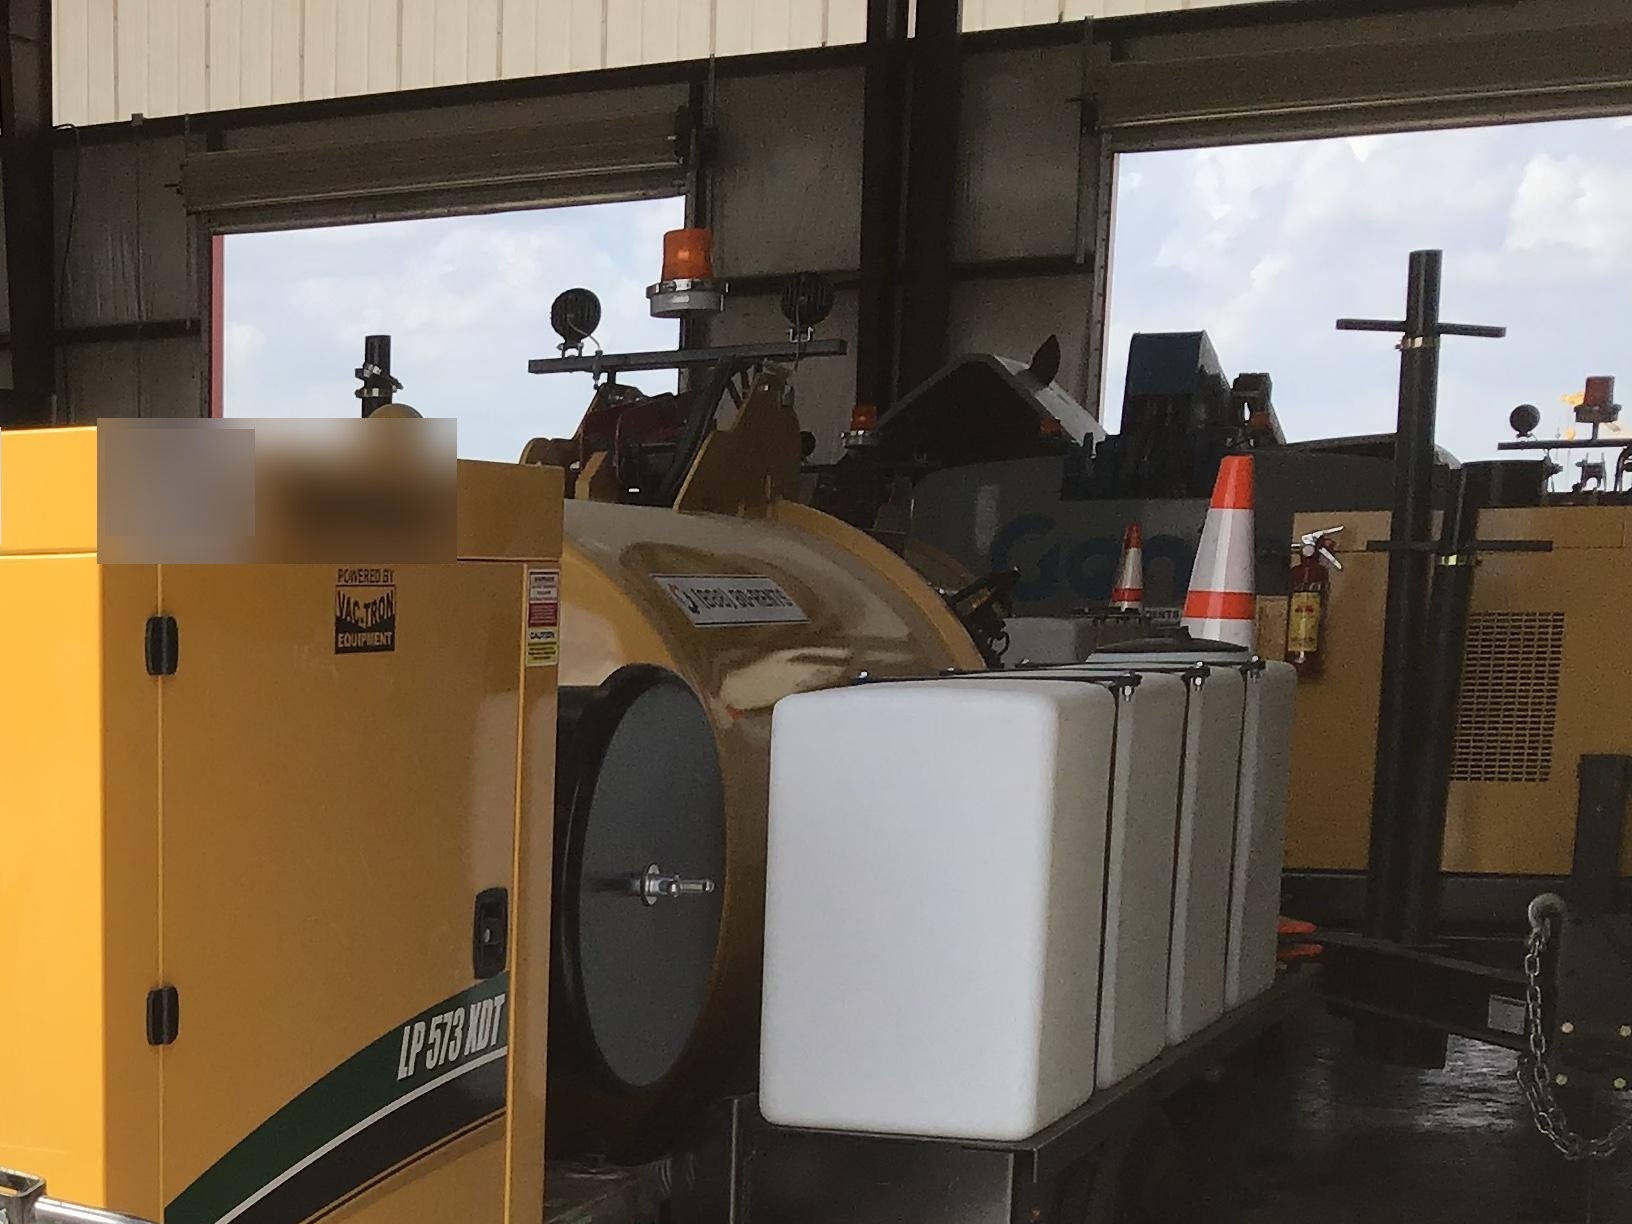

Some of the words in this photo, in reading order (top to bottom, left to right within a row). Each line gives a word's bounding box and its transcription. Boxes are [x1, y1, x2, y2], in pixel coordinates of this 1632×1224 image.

[338, 568, 380, 584] POWERED
[381, 568, 394, 583] BY
[338, 632, 393, 648] EQUIPMENT
[397, 1021, 426, 1080] LP
[426, 1007, 465, 1069] 573
[464, 993, 506, 1056] XDT
